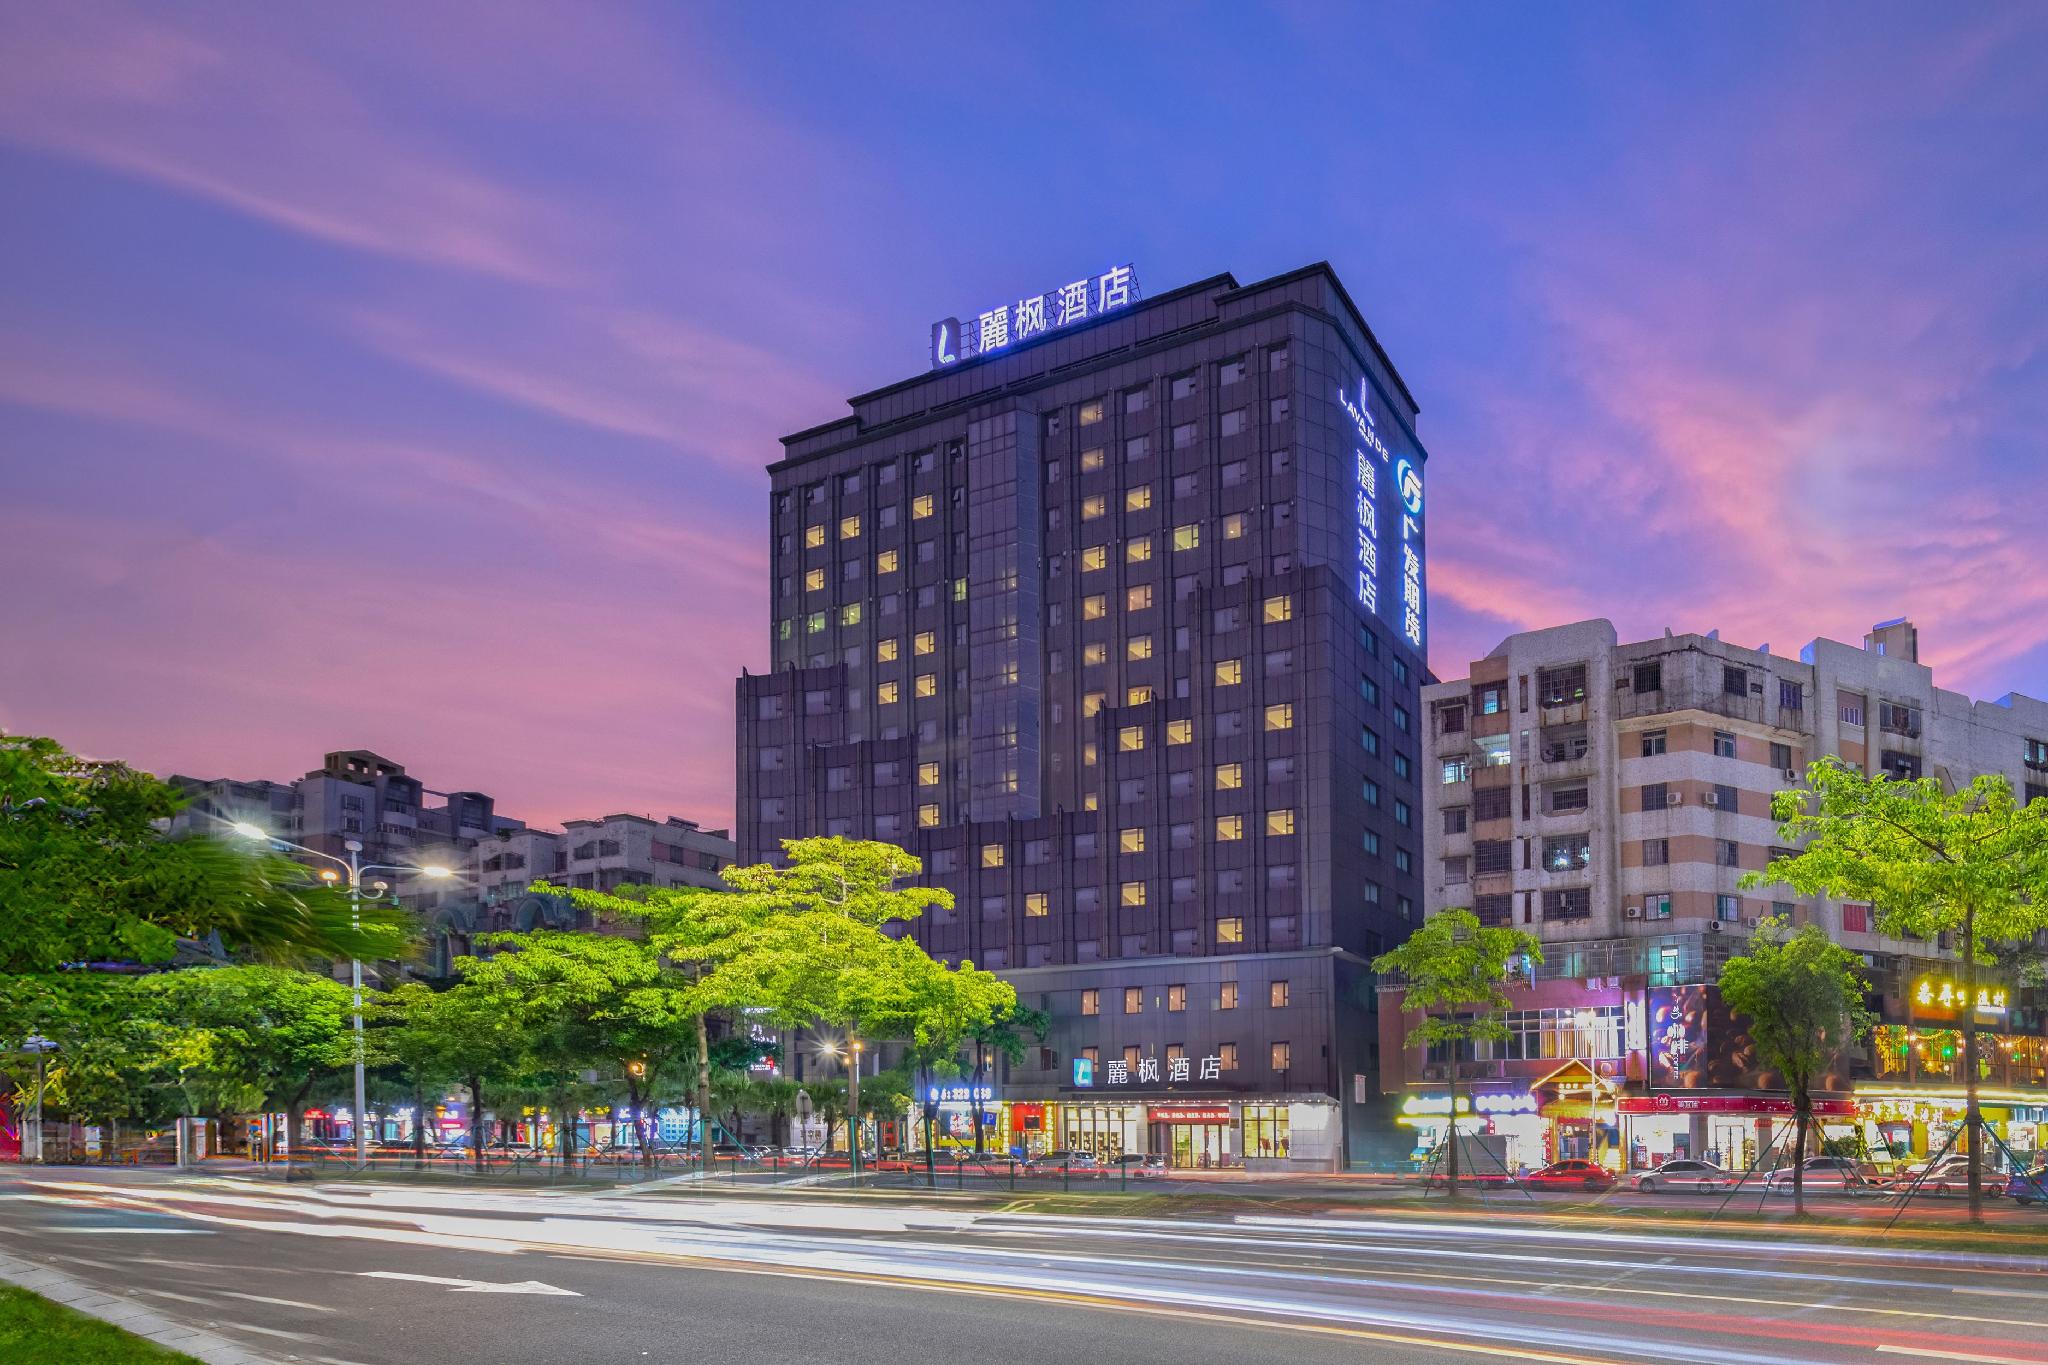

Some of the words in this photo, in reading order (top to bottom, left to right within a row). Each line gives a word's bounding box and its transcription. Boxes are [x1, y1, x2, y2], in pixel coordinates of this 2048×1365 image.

[979, 266, 1131, 353] 麗枫酒店
[1340, 388, 1389, 462] LAVANDE
[1356, 449, 1377, 614] 麗枫酒店
[1107, 1054, 1222, 1085] 麗枫酒店
